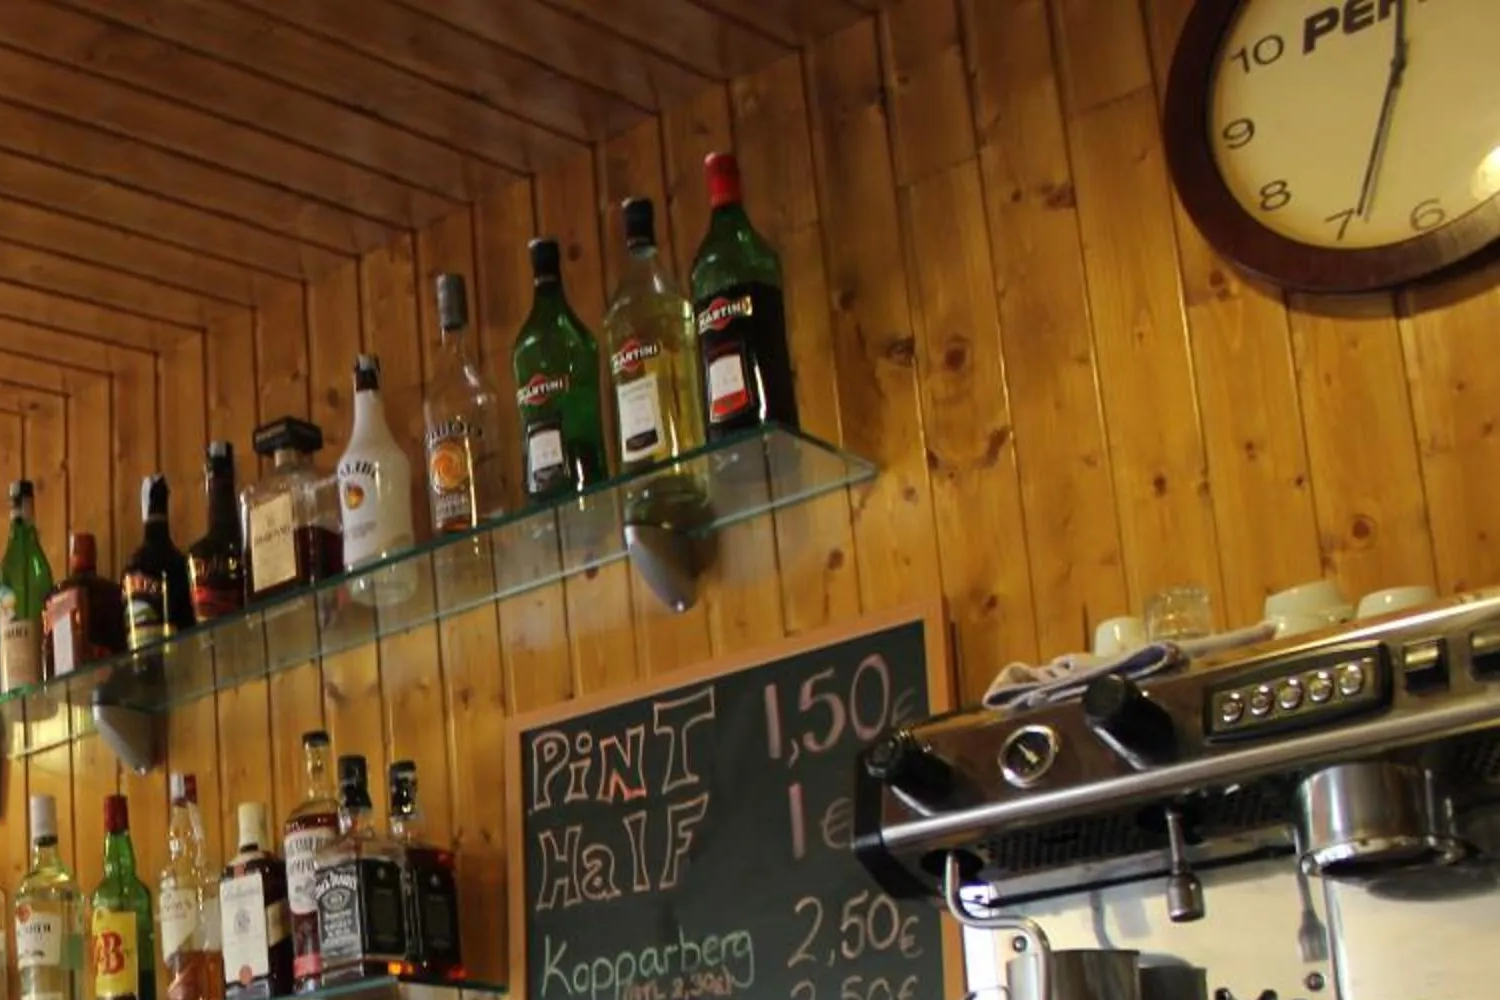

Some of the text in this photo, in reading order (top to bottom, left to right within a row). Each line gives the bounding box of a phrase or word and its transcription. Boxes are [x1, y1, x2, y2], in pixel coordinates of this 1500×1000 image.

[1231, 34, 1284, 73] 10
[1222, 118, 1256, 149] 9
[1259, 180, 1292, 212] 8
[1324, 208, 1356, 241] 7
[1409, 198, 1446, 231] 6
